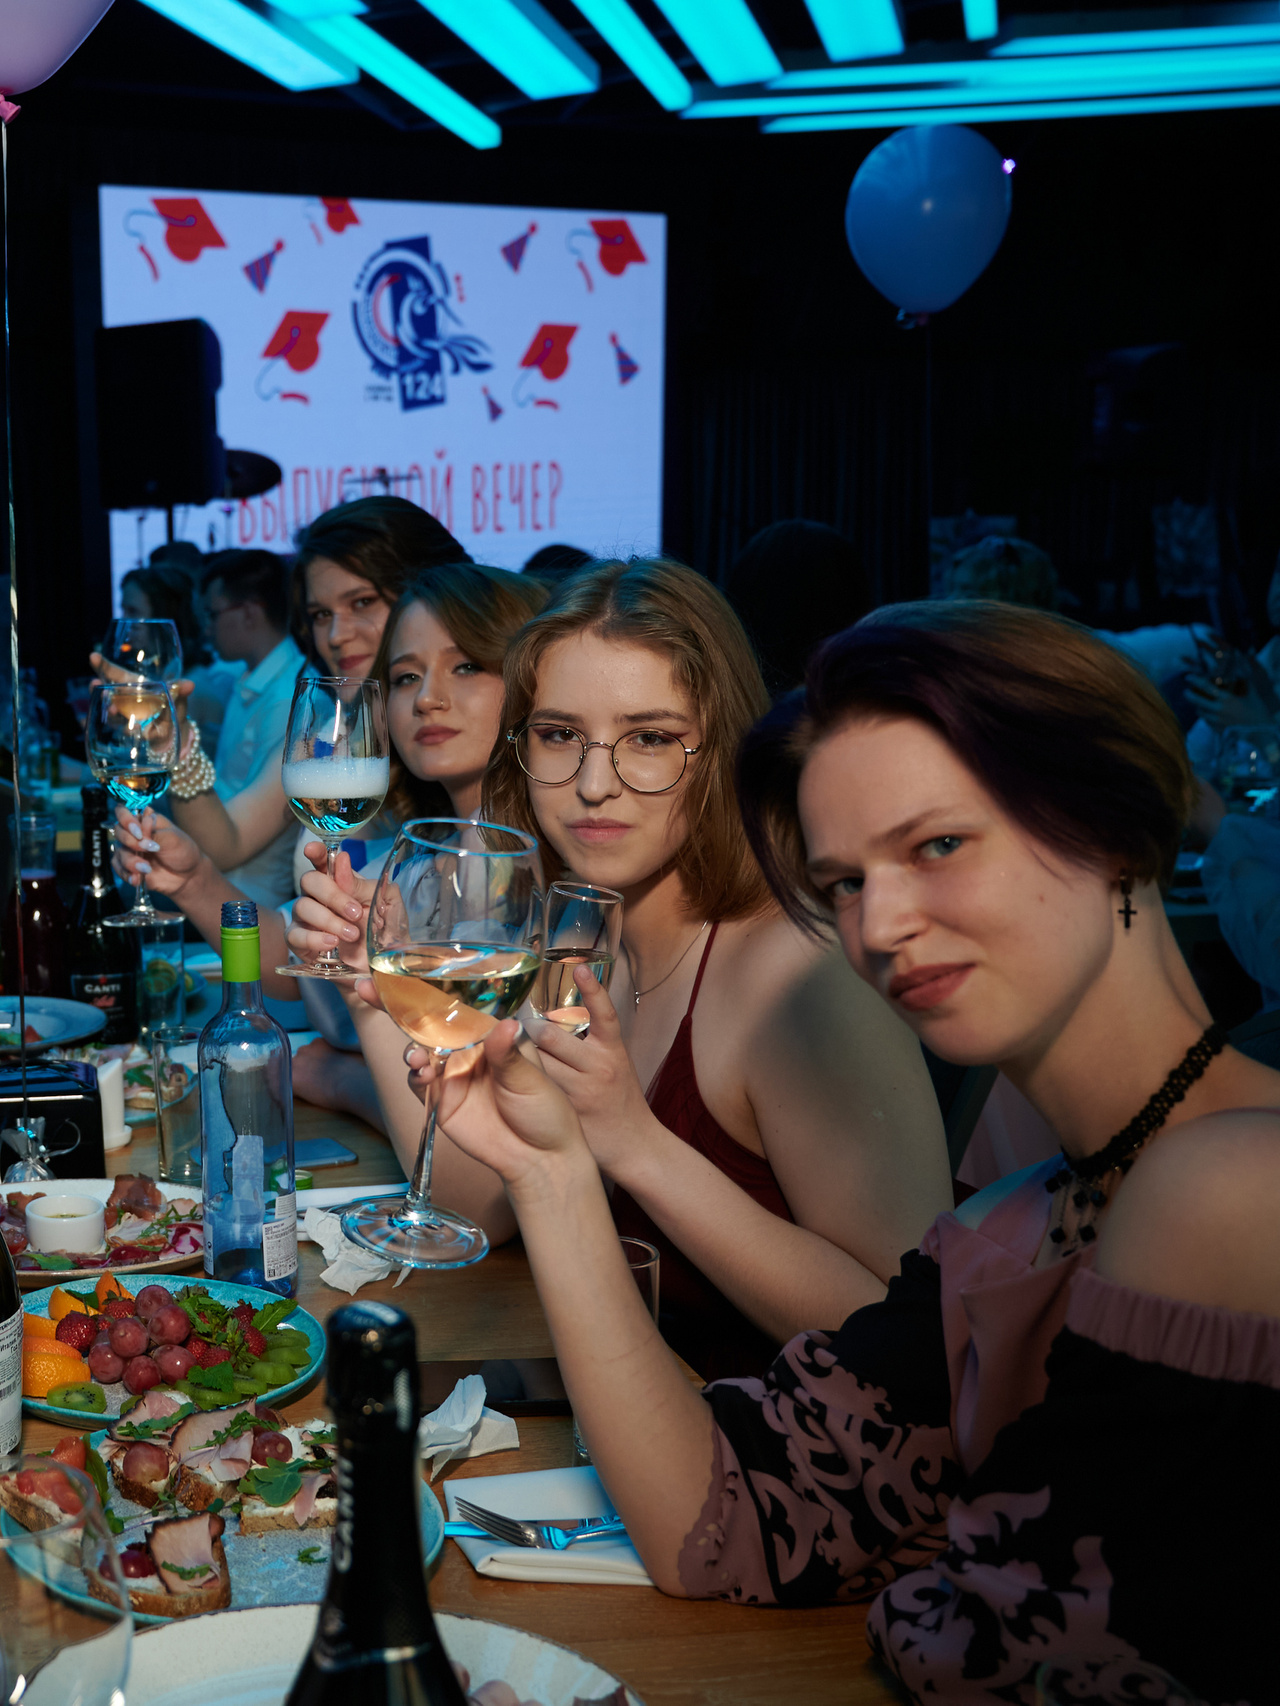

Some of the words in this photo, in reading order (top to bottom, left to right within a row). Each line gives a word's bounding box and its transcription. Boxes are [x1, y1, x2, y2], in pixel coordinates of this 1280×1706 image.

[403, 371, 444, 400] 124
[472, 461, 563, 534] ВЕЧЕР
[92, 829, 101, 867] CANTI
[83, 983, 121, 993] CANTI
